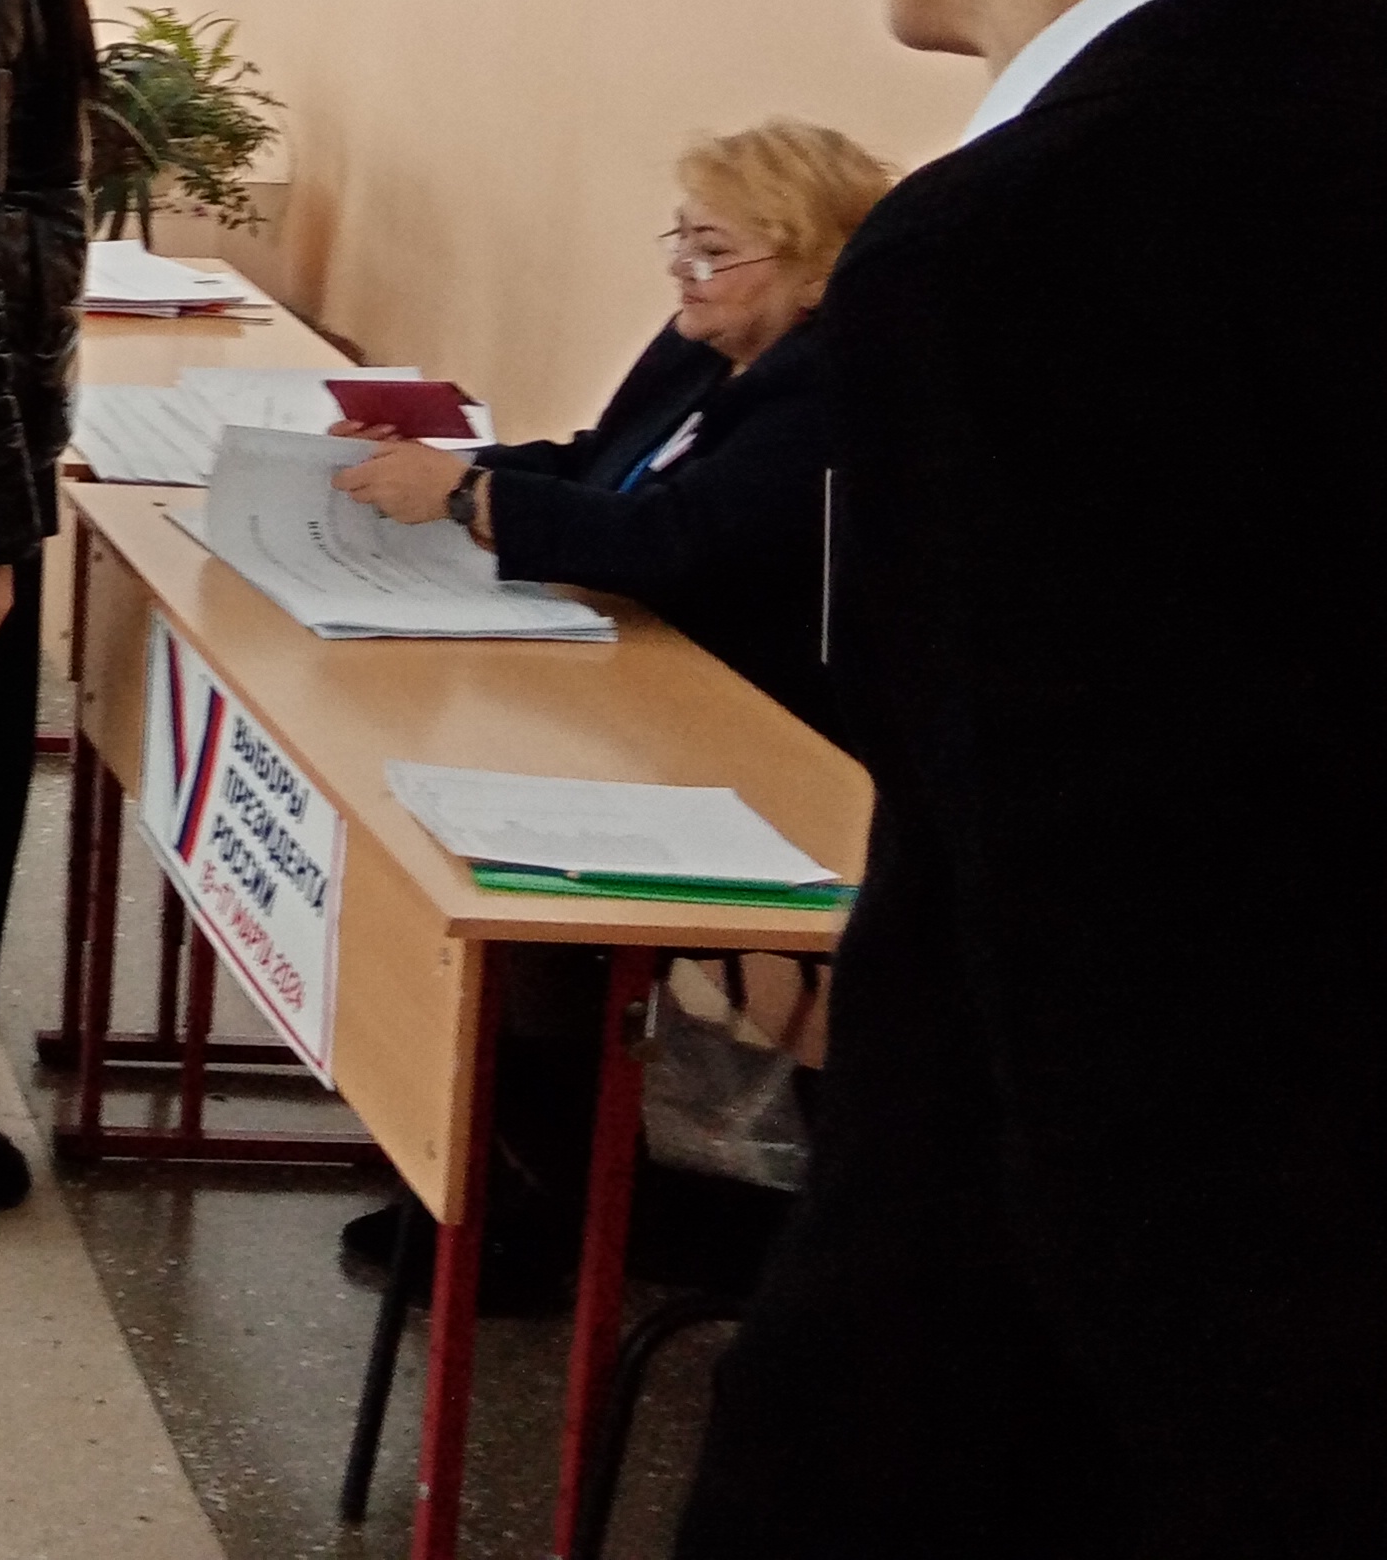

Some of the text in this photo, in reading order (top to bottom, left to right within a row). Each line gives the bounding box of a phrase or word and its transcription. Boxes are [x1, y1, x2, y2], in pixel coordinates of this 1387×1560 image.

[231, 716, 309, 824] ВЫБОРЫ
[210, 814, 279, 917] РОССИИ
[221, 765, 328, 918] ПРЕЗИДЕНТА
